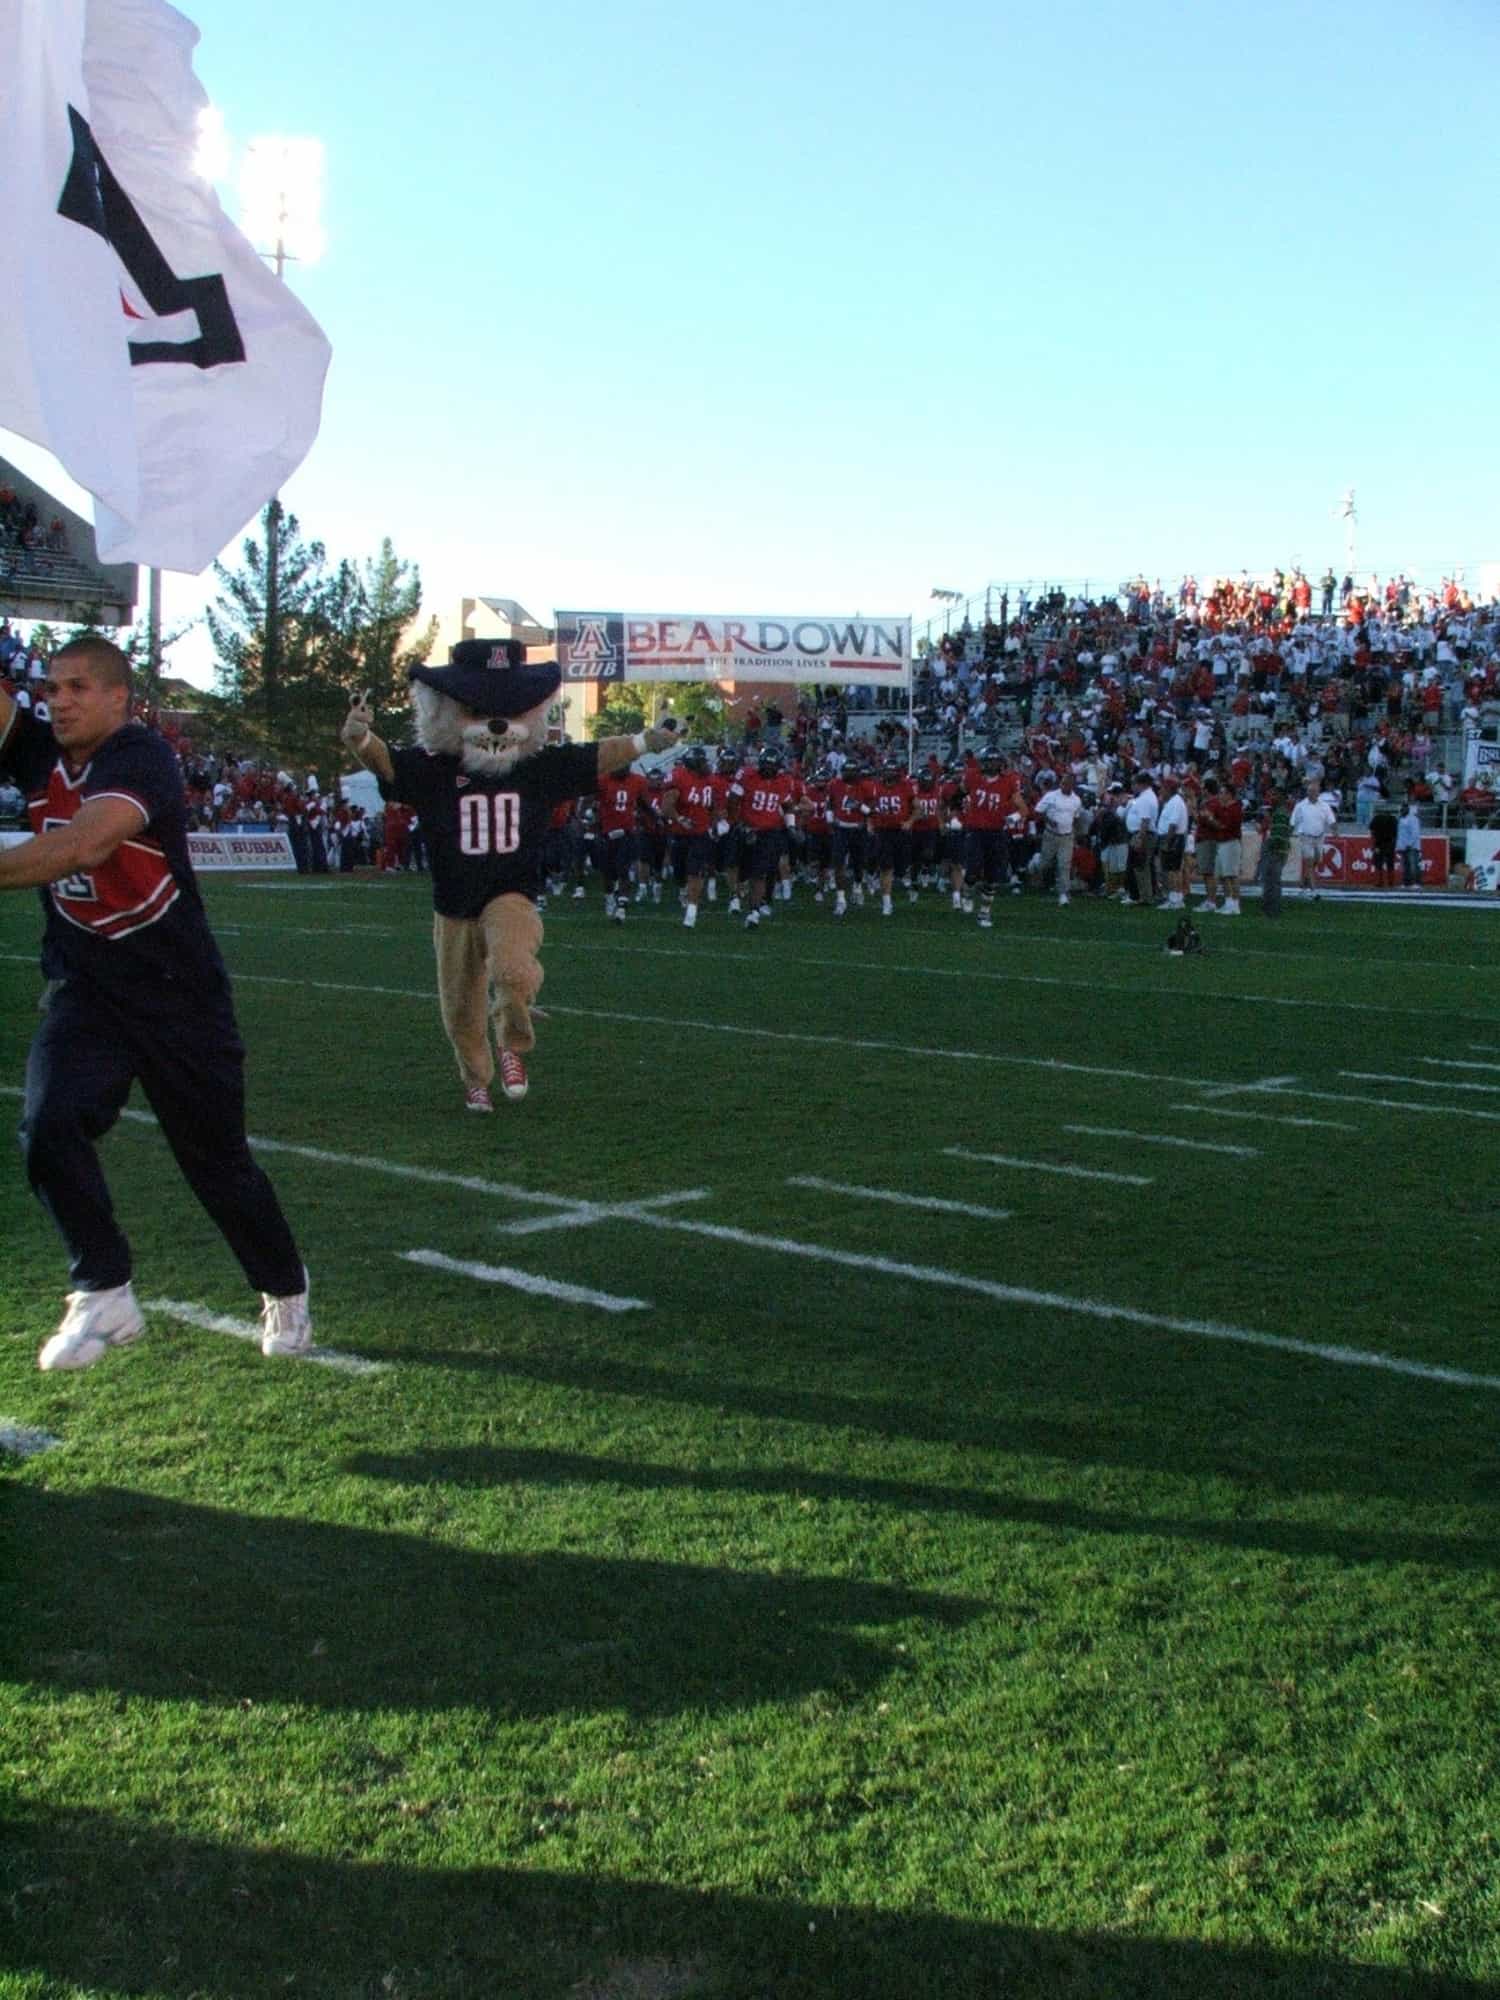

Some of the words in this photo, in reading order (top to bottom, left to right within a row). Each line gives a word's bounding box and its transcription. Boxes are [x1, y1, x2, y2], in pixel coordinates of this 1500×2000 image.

[568, 615, 617, 661] A
[487, 646, 510, 669] A
[733, 657, 794, 667] TRADITION
[797, 659, 827, 668] LIVES
[568, 661, 617, 678] CLUB
[459, 792, 521, 855] 00
